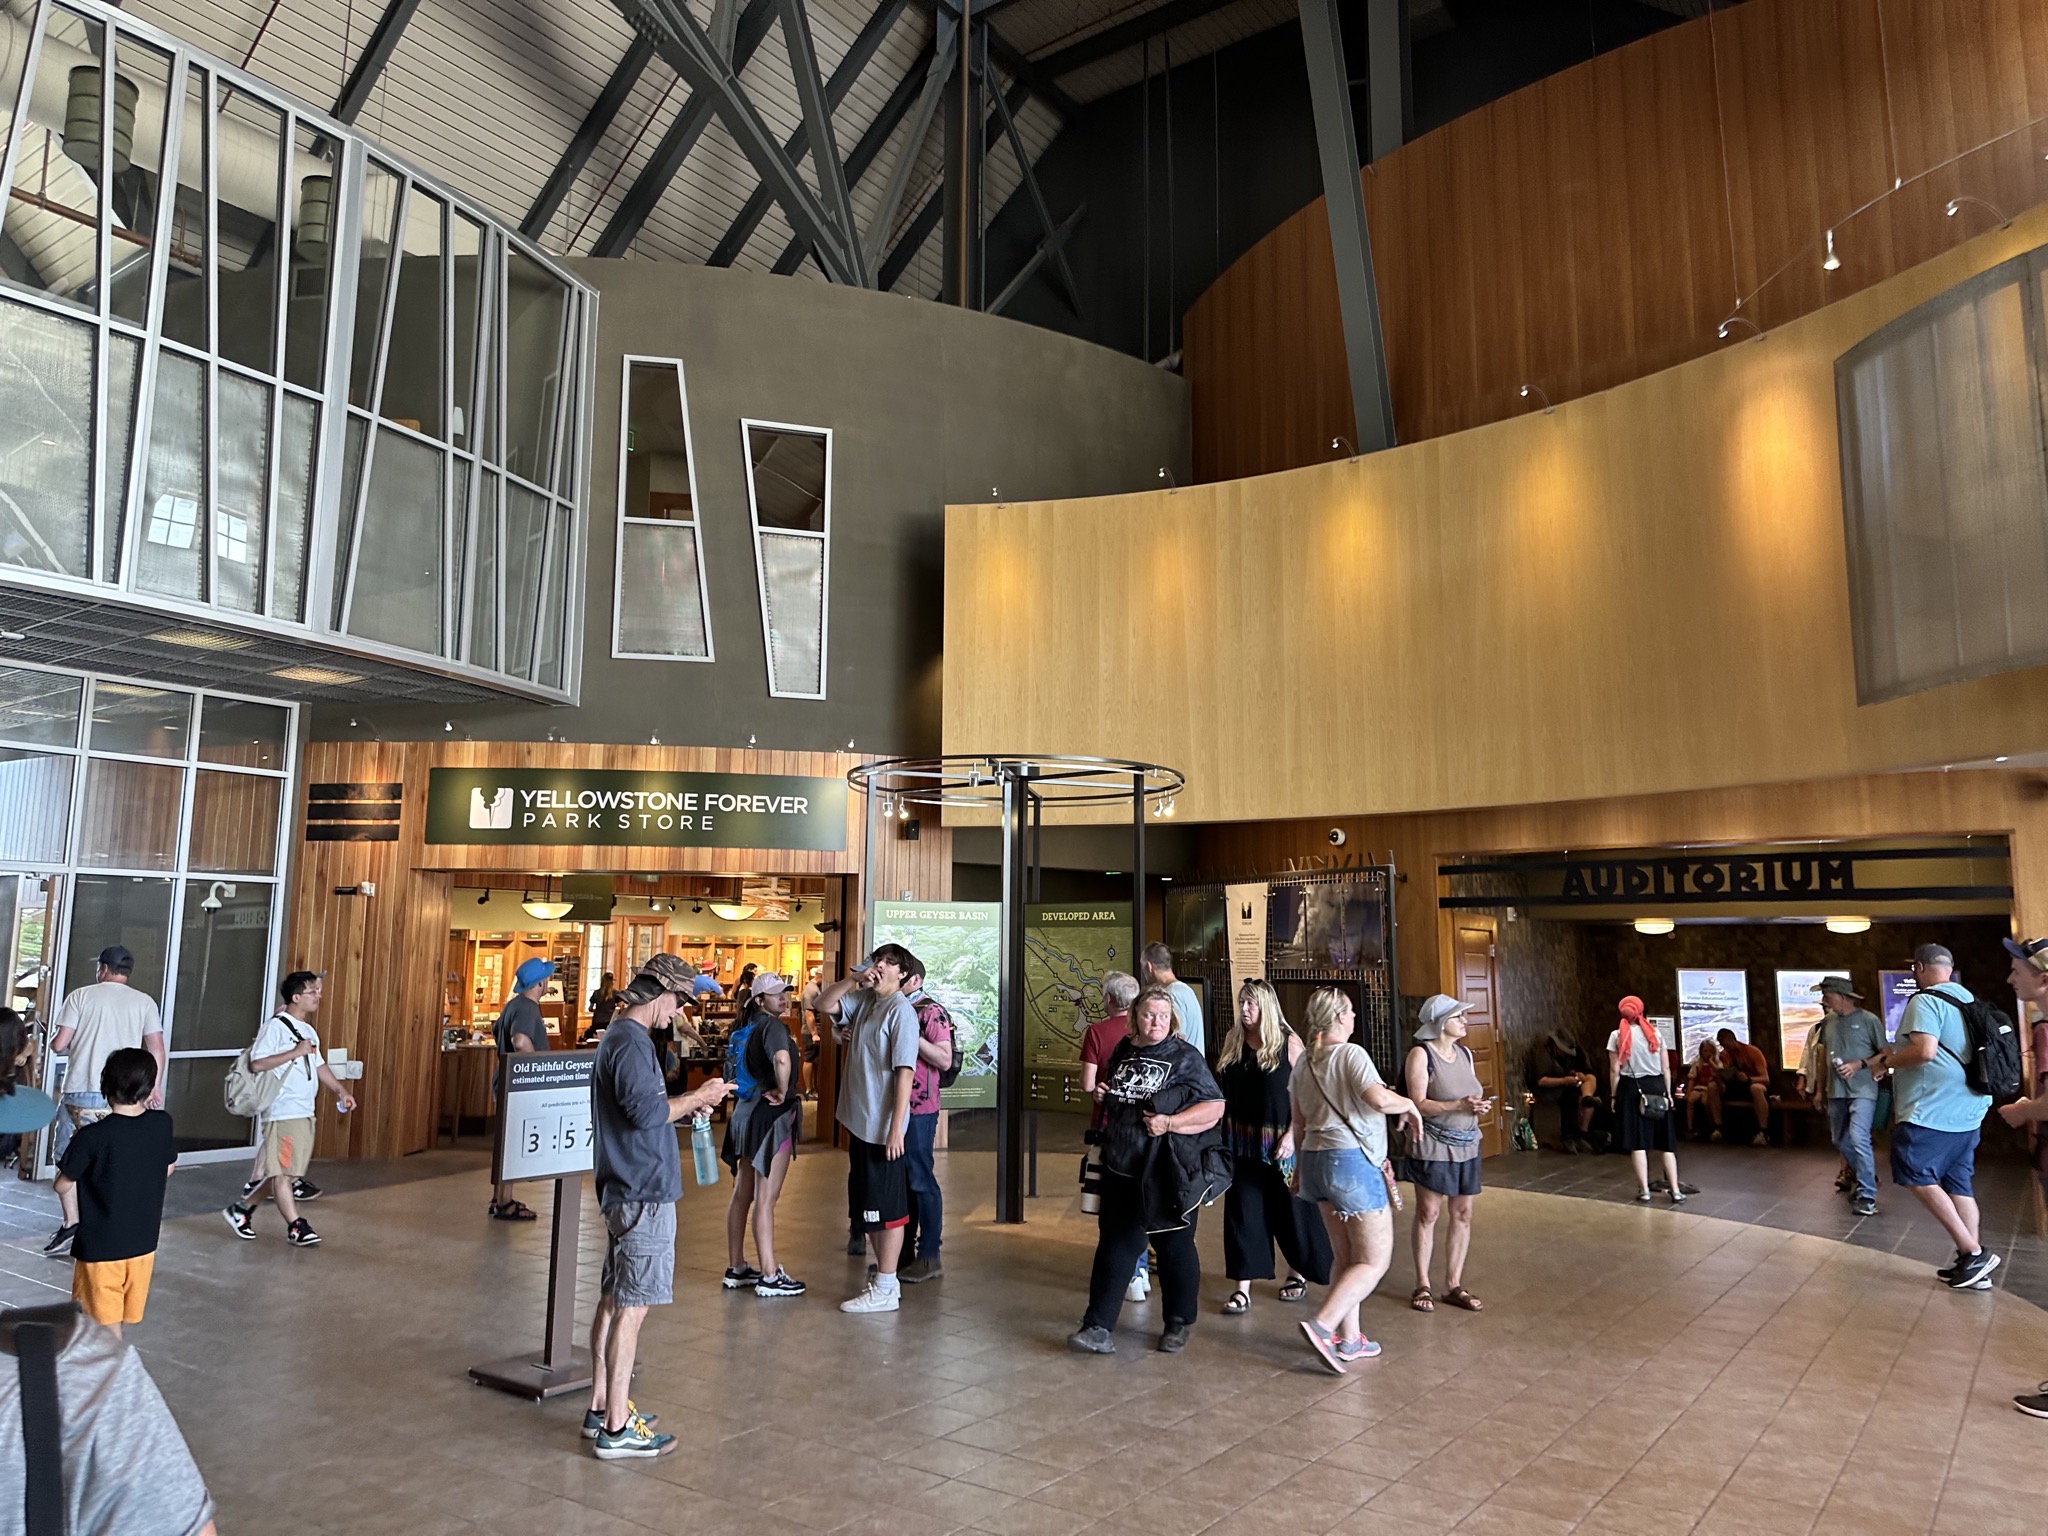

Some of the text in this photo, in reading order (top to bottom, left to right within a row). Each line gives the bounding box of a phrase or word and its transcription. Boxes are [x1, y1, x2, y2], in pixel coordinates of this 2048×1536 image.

[519, 789, 809, 815] YELLOWSTONE FOREVER
[522, 812, 715, 832] PARK STORE
[1562, 858, 1854, 897] AUDITORIUM
[886, 909, 989, 921] UPPER GEYSER BASIN
[1041, 911, 1116, 922] DEVELOPED AREA
[513, 1060, 594, 1074] Old Faithful Geyser
[512, 1072, 590, 1085] estimated eruption time
[548, 1101, 572, 1109] predictions
